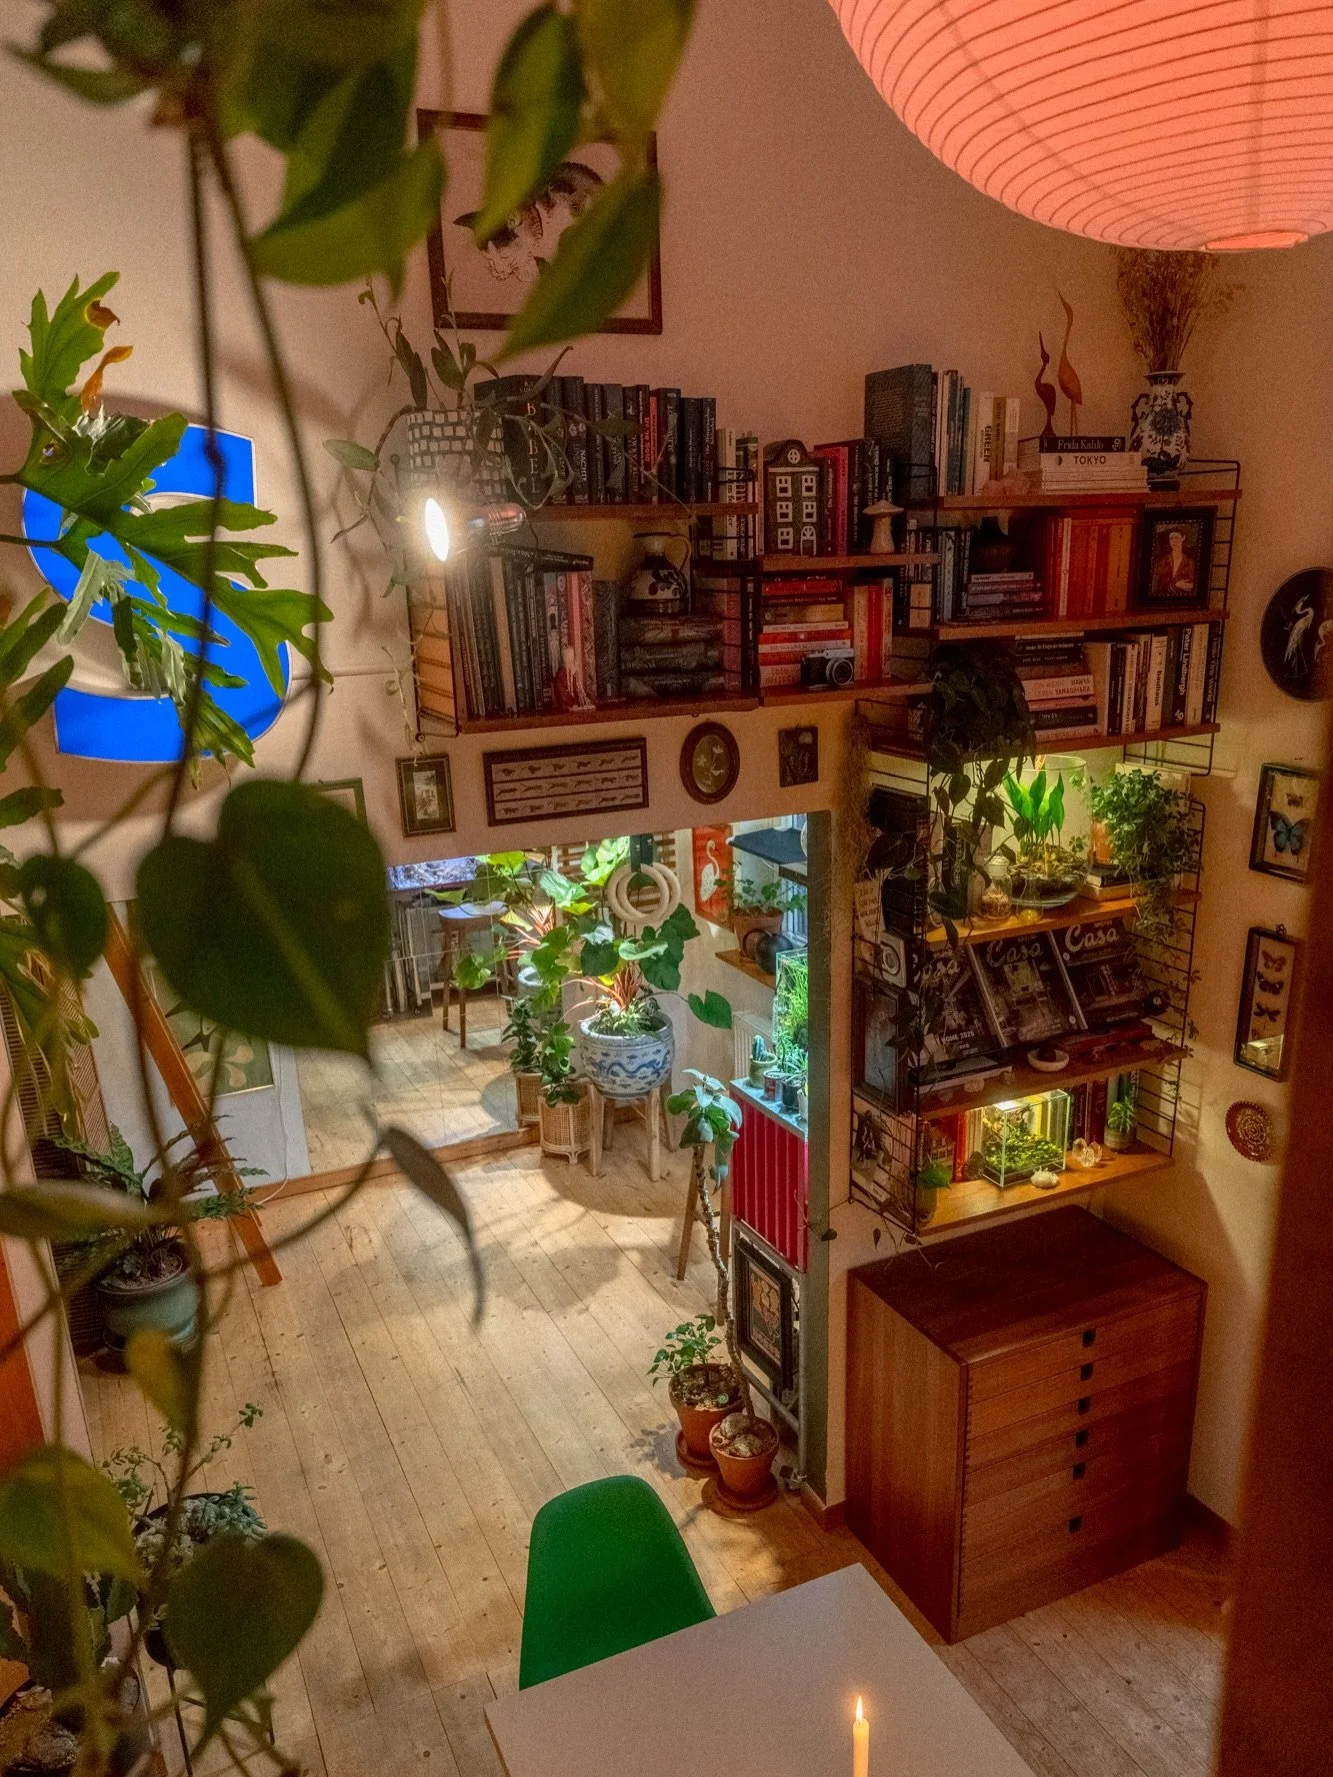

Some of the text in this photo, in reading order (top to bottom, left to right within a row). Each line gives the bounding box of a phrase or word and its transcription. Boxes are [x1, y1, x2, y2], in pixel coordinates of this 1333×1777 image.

[983, 425, 992, 463] GREEN
[1058, 439, 1104, 450] Frida Kahlo
[1073, 455, 1107, 465] TOKYO
[22, 421, 292, 764] S
[1178, 627, 1192, 696] Peter Lindbergh
[1055, 685, 1091, 695] YANAGIHARA
[1071, 678, 1090, 686] HANYA
[1154, 670, 1163, 707] bauhaus
[986, 938, 1043, 968] Casa
[1065, 924, 1120, 953] Casa
